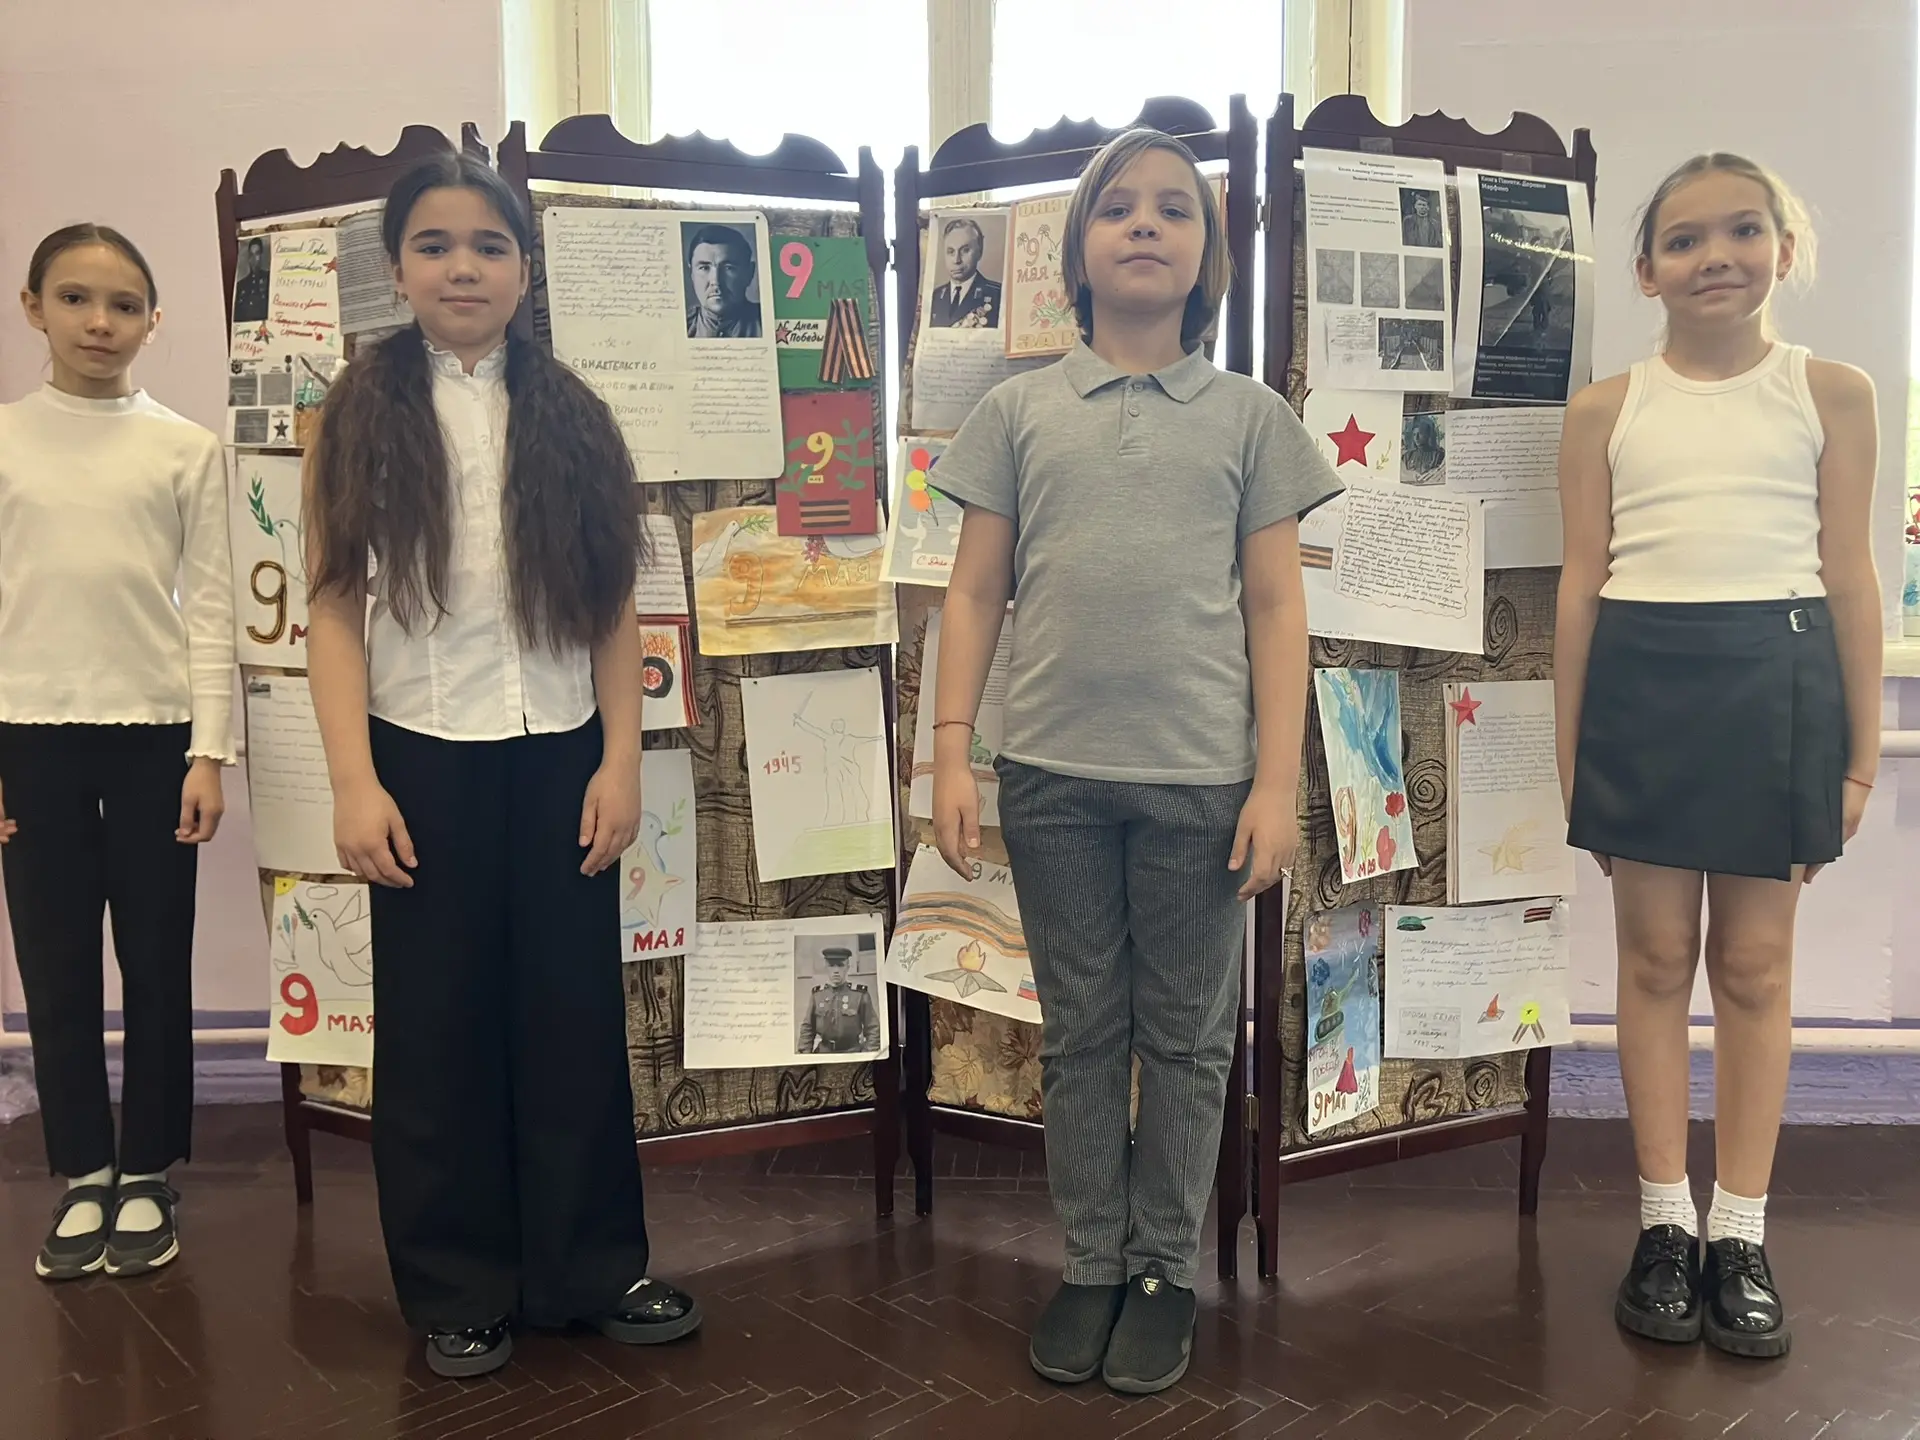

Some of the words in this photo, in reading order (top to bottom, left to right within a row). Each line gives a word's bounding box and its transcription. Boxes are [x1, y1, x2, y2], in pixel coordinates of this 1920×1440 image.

[780, 242, 813, 298] 9
[1026, 238, 1039, 266] 9
[817, 279, 864, 298] МАЯ
[790, 332, 823, 343] Победы
[801, 432, 834, 471] 9
[727, 552, 763, 616] 9
[797, 561, 870, 590] МАЯ
[246, 560, 287, 644] 9
[289, 623, 309, 645] М
[763, 753, 801, 775] 1945
[1335, 787, 1357, 864] 9
[626, 866, 646, 900] 9
[633, 928, 684, 952] МАЯ
[280, 973, 319, 1036] 9
[328, 1014, 374, 1034] МАЯ
